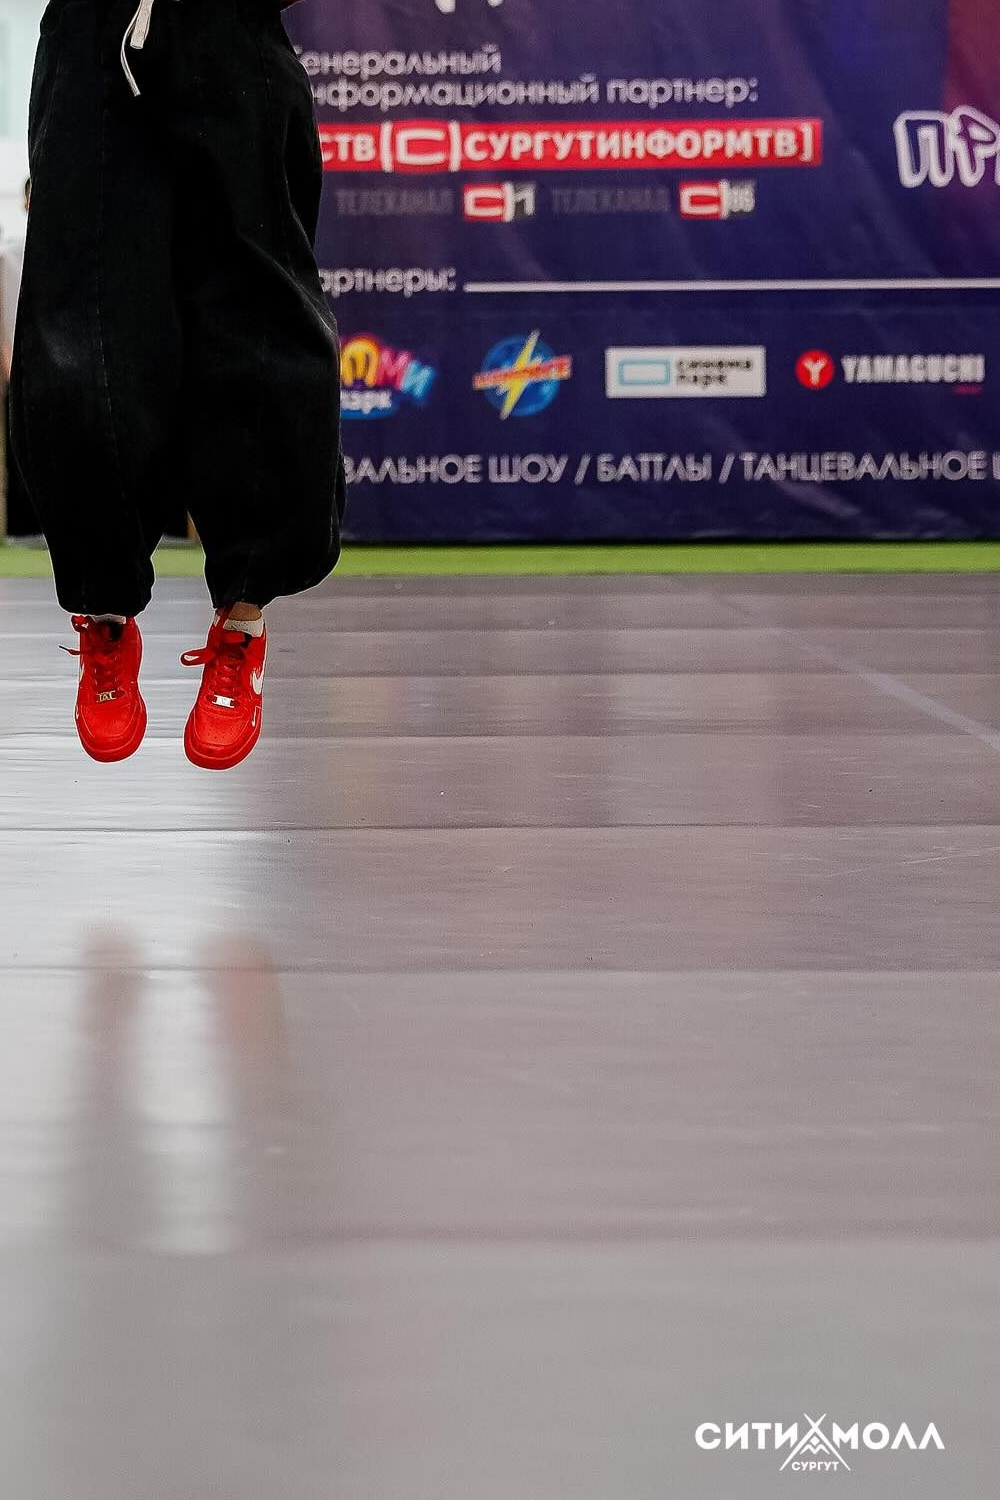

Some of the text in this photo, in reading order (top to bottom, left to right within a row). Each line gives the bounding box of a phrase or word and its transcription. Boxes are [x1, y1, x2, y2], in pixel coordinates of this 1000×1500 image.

[294, 43, 502, 80] енеральный
[312, 71, 759, 112] нформационный партнер:
[892, 104, 1000, 189] ПР
[318, 267, 456, 298] артнеры:
[840, 353, 986, 384] YAMAGUCHI
[344, 452, 483, 484] ВАЛЬНОЕ
[488, 453, 569, 484] ШОУ
[597, 451, 713, 483] БАТТЛЫ
[740, 450, 987, 483] ТАНЦЕВАЛЬНОЕ
